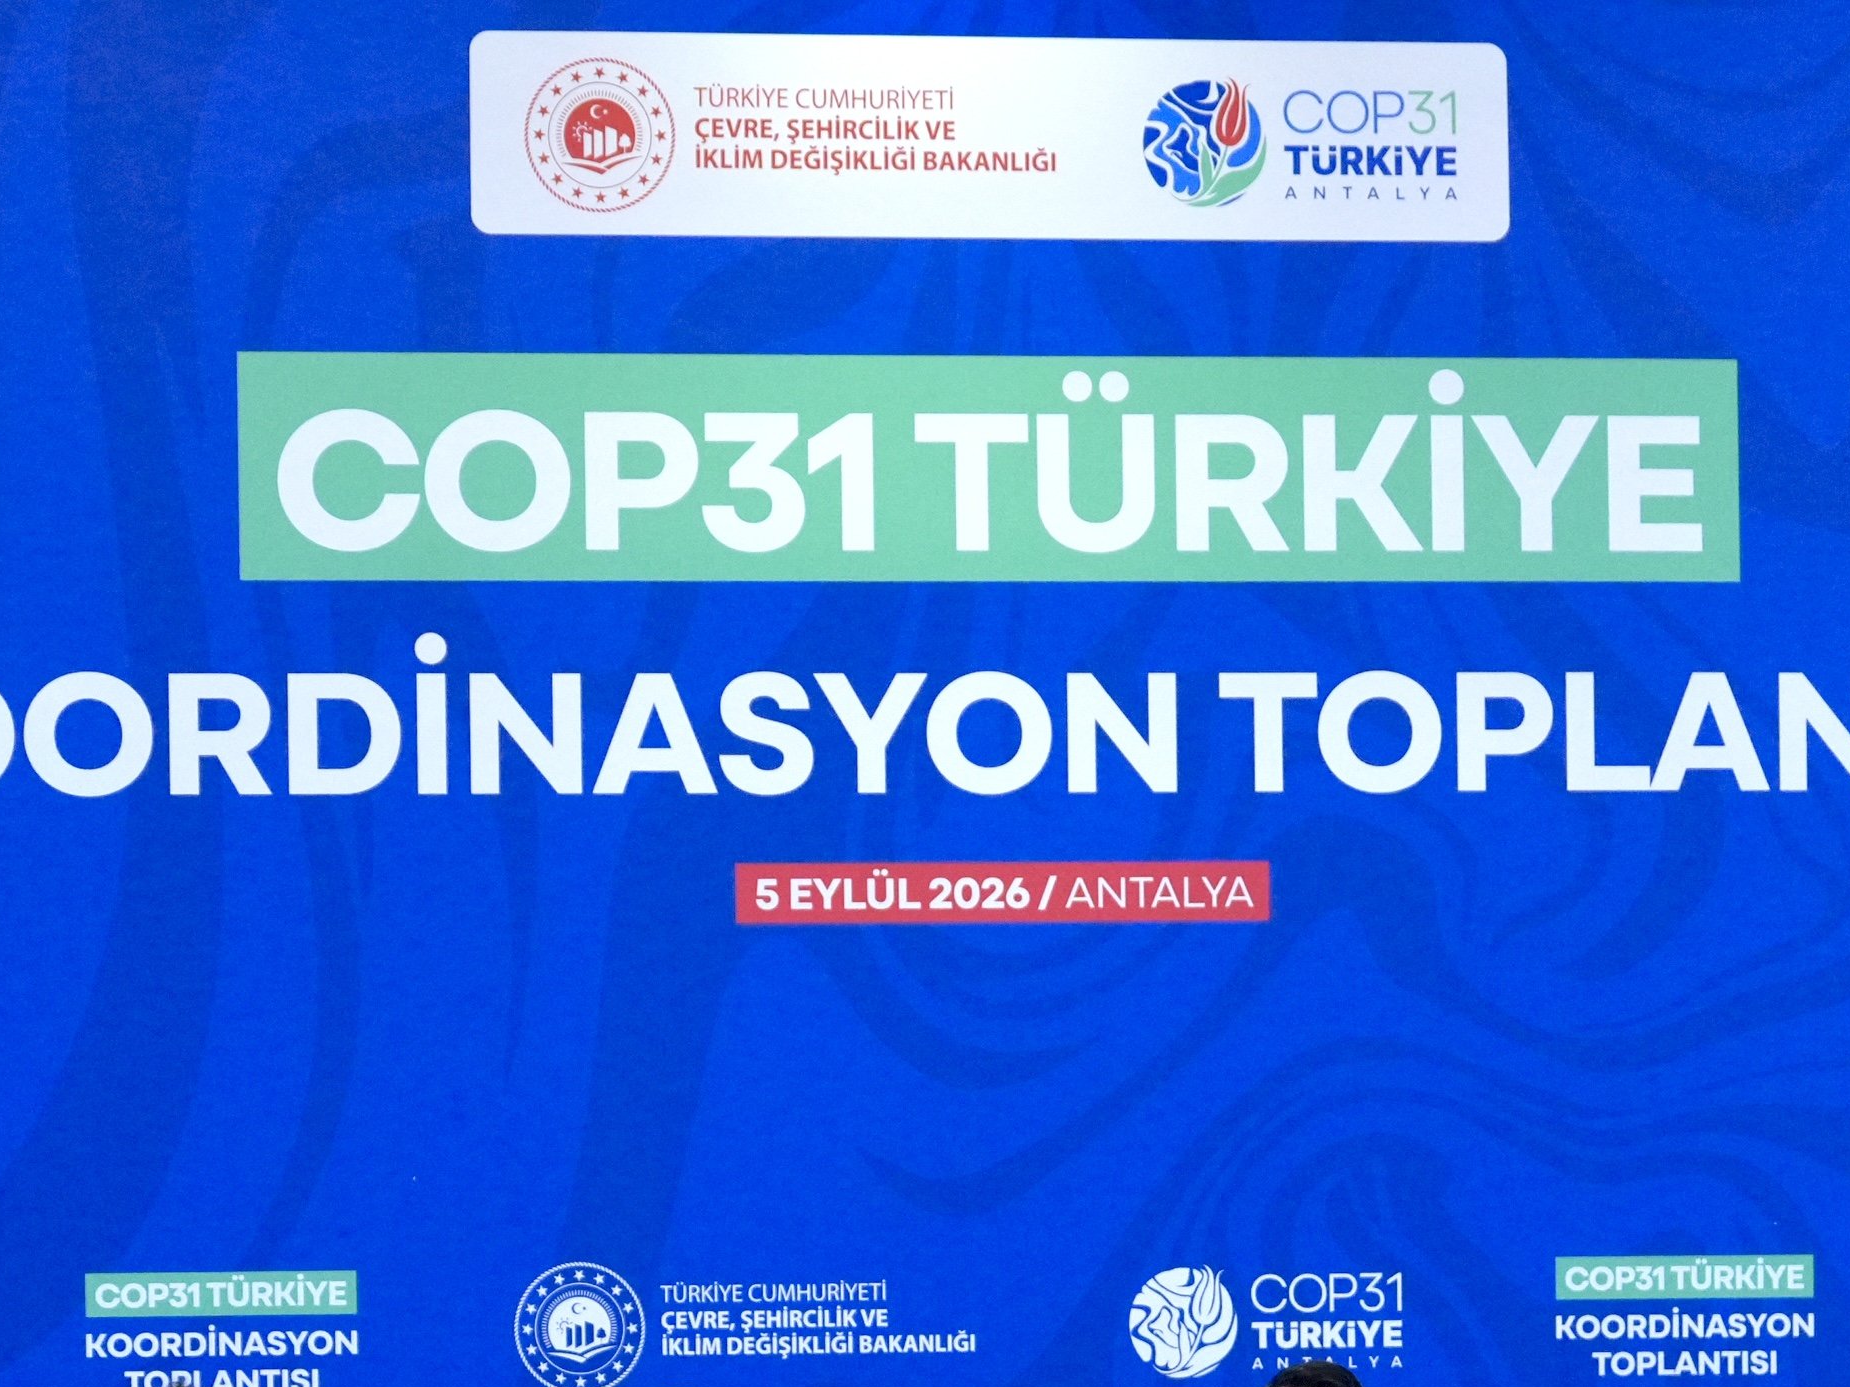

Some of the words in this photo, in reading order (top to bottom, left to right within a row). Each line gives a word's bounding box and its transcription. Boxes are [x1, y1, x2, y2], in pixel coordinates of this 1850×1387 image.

[693, 83, 789, 109] TÜRKİYE
[795, 87, 954, 110] CUMHURİYETİ
[1282, 89, 1457, 135] COP31
[694, 118, 779, 146] ÇEVRE,
[786, 115, 920, 150] ŞEHİRCİLİK
[924, 120, 956, 141] VE
[695, 143, 763, 169] İKLİM
[770, 145, 916, 176] DEĞİŞİKLİĞİ
[923, 147, 1056, 172] BAKANLIĞI
[1283, 145, 1457, 177] TÜRKİYE
[1284, 185, 1458, 201] ANTALYA
[277, 408, 875, 553] COP31
[914, 369, 1703, 554] TÜRKİYE
[755, 878, 779, 911] 5
[789, 868, 922, 911] EYLÜL
[928, 875, 1031, 911] 2026
[1037, 874, 1058, 911] /
[1064, 875, 1254, 910] ANTALYA
[1564, 1265, 1665, 1292] COP31
[1670, 1257, 1805, 1291] TÜRKİYE
[95, 1282, 201, 1309] COP31
[207, 1275, 348, 1308] TÜRKİYE
[659, 1281, 743, 1304] TÜRKİYE
[747, 1279, 887, 1303] CUMHURİYETİ
[1250, 1272, 1403, 1314] COP31
[660, 1310, 736, 1334] ÇEVRE,
[740, 1305, 857, 1333] ŞEHİRCİLİK
[860, 1308, 889, 1328] VE
[1251, 1319, 1403, 1349] TÜRKİYE
[1555, 1306, 1815, 1340] KOORDİNASYON
[85, 1324, 358, 1358] KOORDİNASYON
[661, 1330, 722, 1356] İKLİM
[727, 1329, 854, 1360] DEĞİŞİKLİĞİ
[859, 1329, 976, 1354] BAKANLIĞI
[1591, 1349, 1778, 1377] TOPLANTISI
